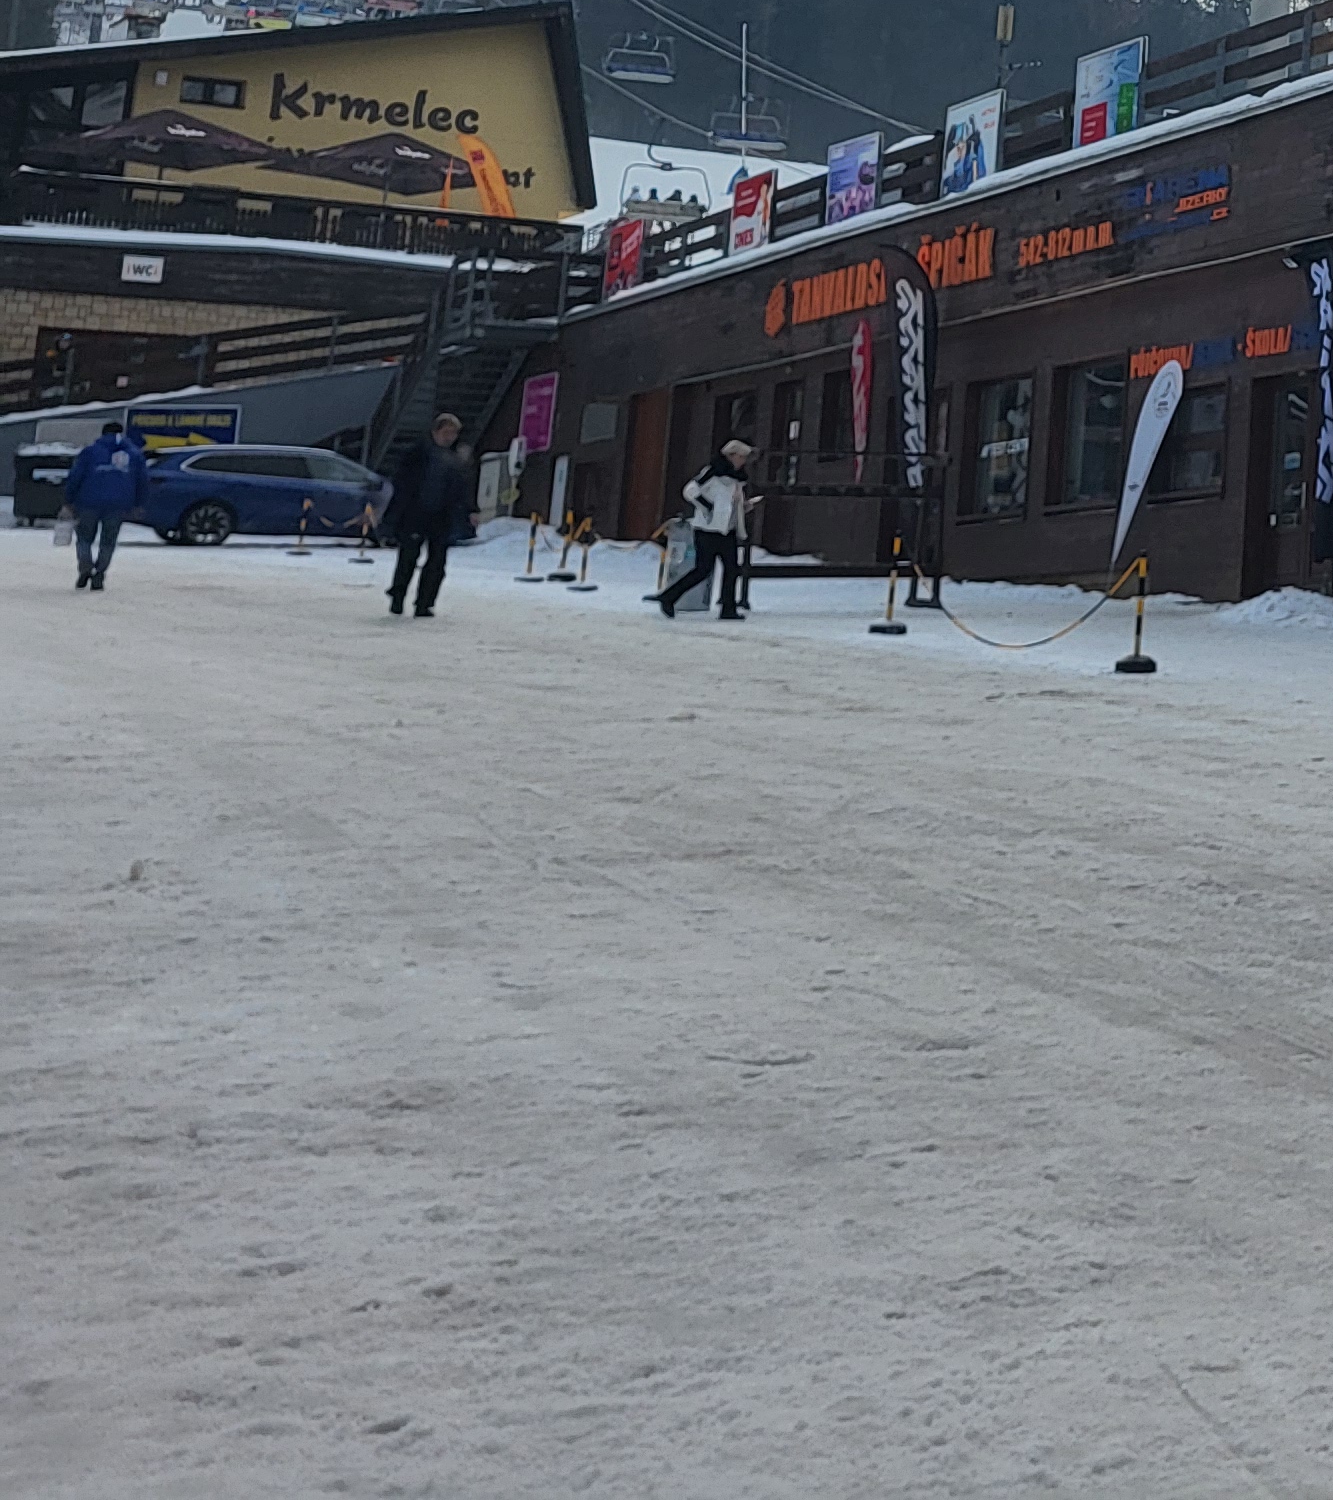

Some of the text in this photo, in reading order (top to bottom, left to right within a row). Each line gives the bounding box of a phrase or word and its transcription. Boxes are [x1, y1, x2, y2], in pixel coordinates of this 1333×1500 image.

[268, 72, 480, 134] Krmelec
[791, 257, 887, 325] TANVALDS
[916, 221, 995, 289] ŠPIČÁK
